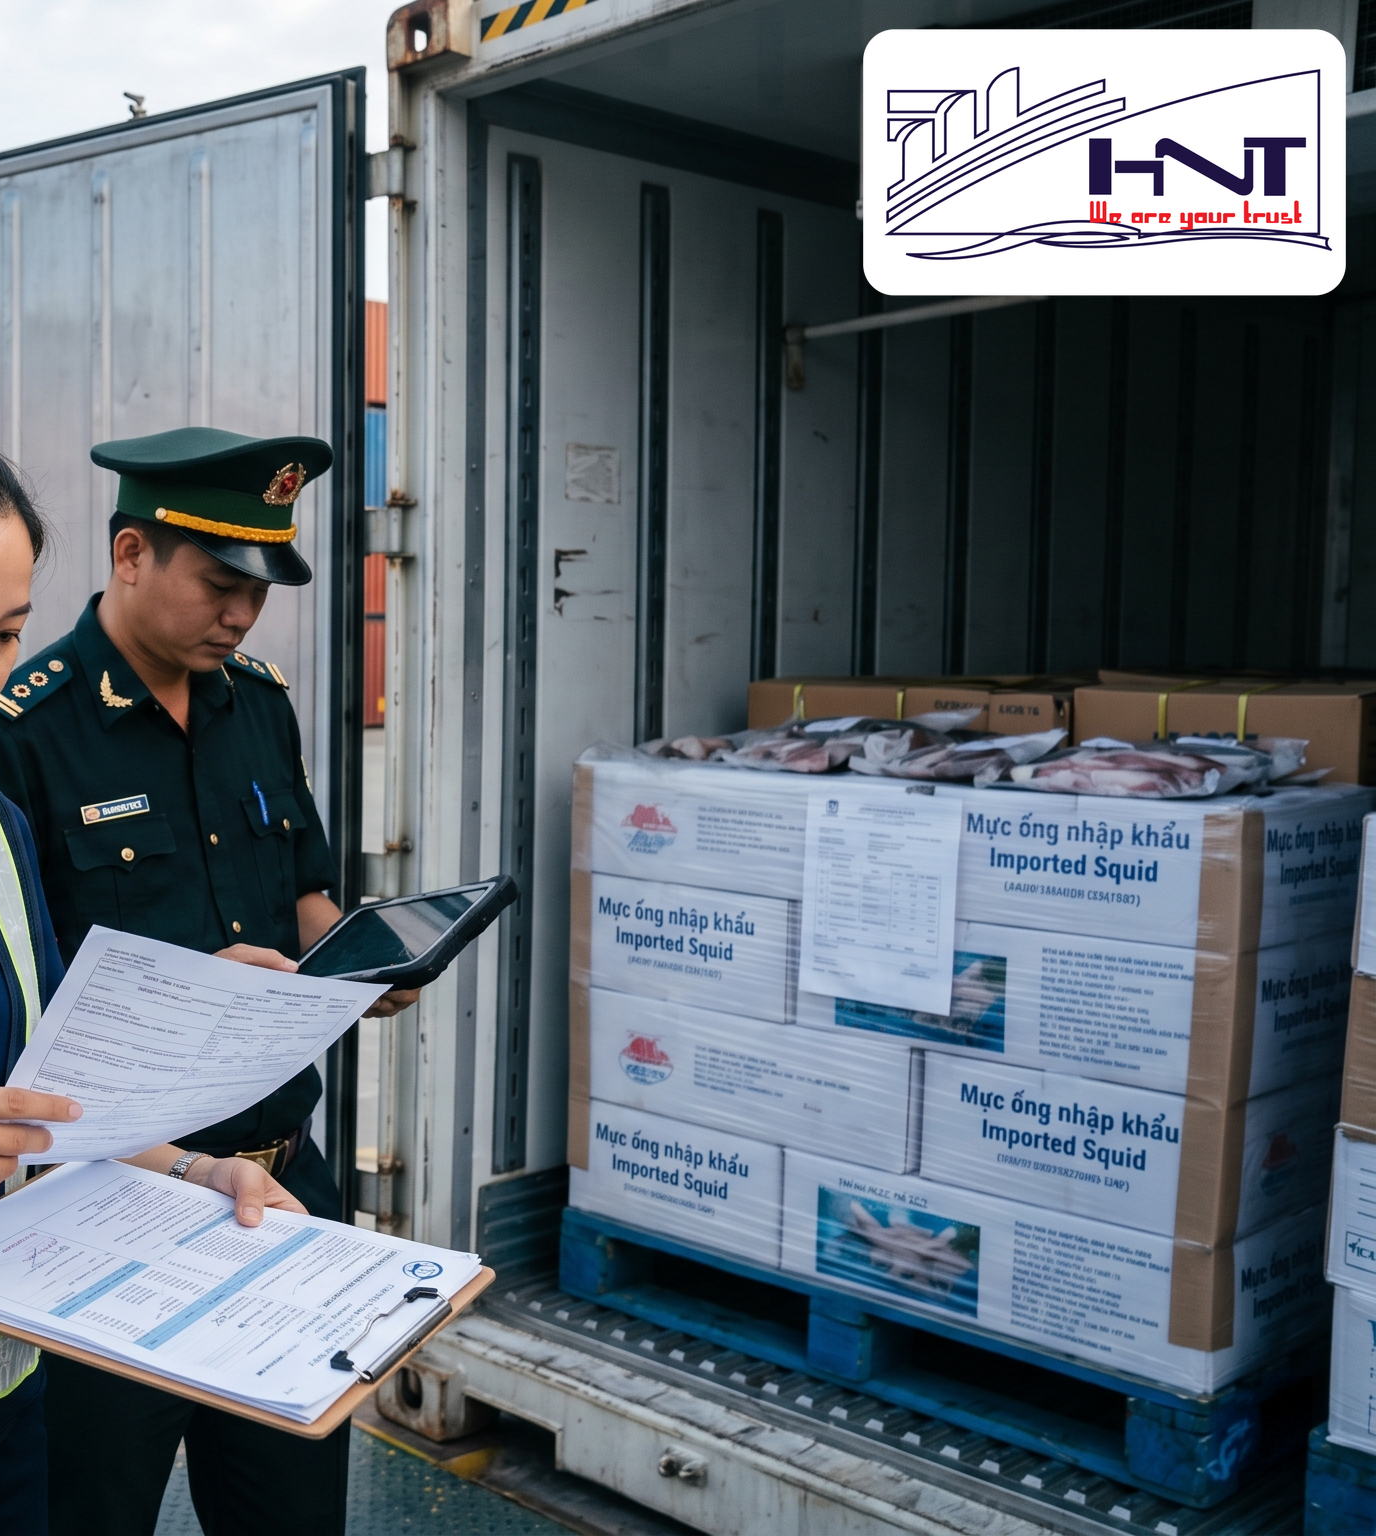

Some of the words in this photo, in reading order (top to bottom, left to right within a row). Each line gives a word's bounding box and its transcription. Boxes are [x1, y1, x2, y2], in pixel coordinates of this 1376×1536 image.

[966, 813, 1011, 836] Mực
[1018, 812, 1059, 845] ống
[1067, 820, 1123, 848] nhập
[1131, 820, 1190, 850] khẩu
[989, 847, 1087, 877] Imported
[1094, 856, 1159, 885] Squid
[598, 896, 630, 919] Mực
[635, 900, 664, 927] ống
[669, 907, 708, 934] nhập
[713, 911, 755, 937] khẩu
[616, 926, 684, 953] Imported
[689, 939, 734, 962] Squid
[960, 1083, 1004, 1112] Mực
[1011, 1089, 1051, 1125] ống
[1058, 1103, 1114, 1136] nhập
[1122, 1112, 1179, 1144] khẩu
[596, 1122, 627, 1148] Mực
[631, 1130, 659, 1159] ống
[664, 1141, 702, 1171] nhập
[982, 1119, 1076, 1157] Imported
[1082, 1139, 1146, 1172] Squid
[612, 1154, 679, 1187] Imported
[684, 1171, 728, 1200] Squid
